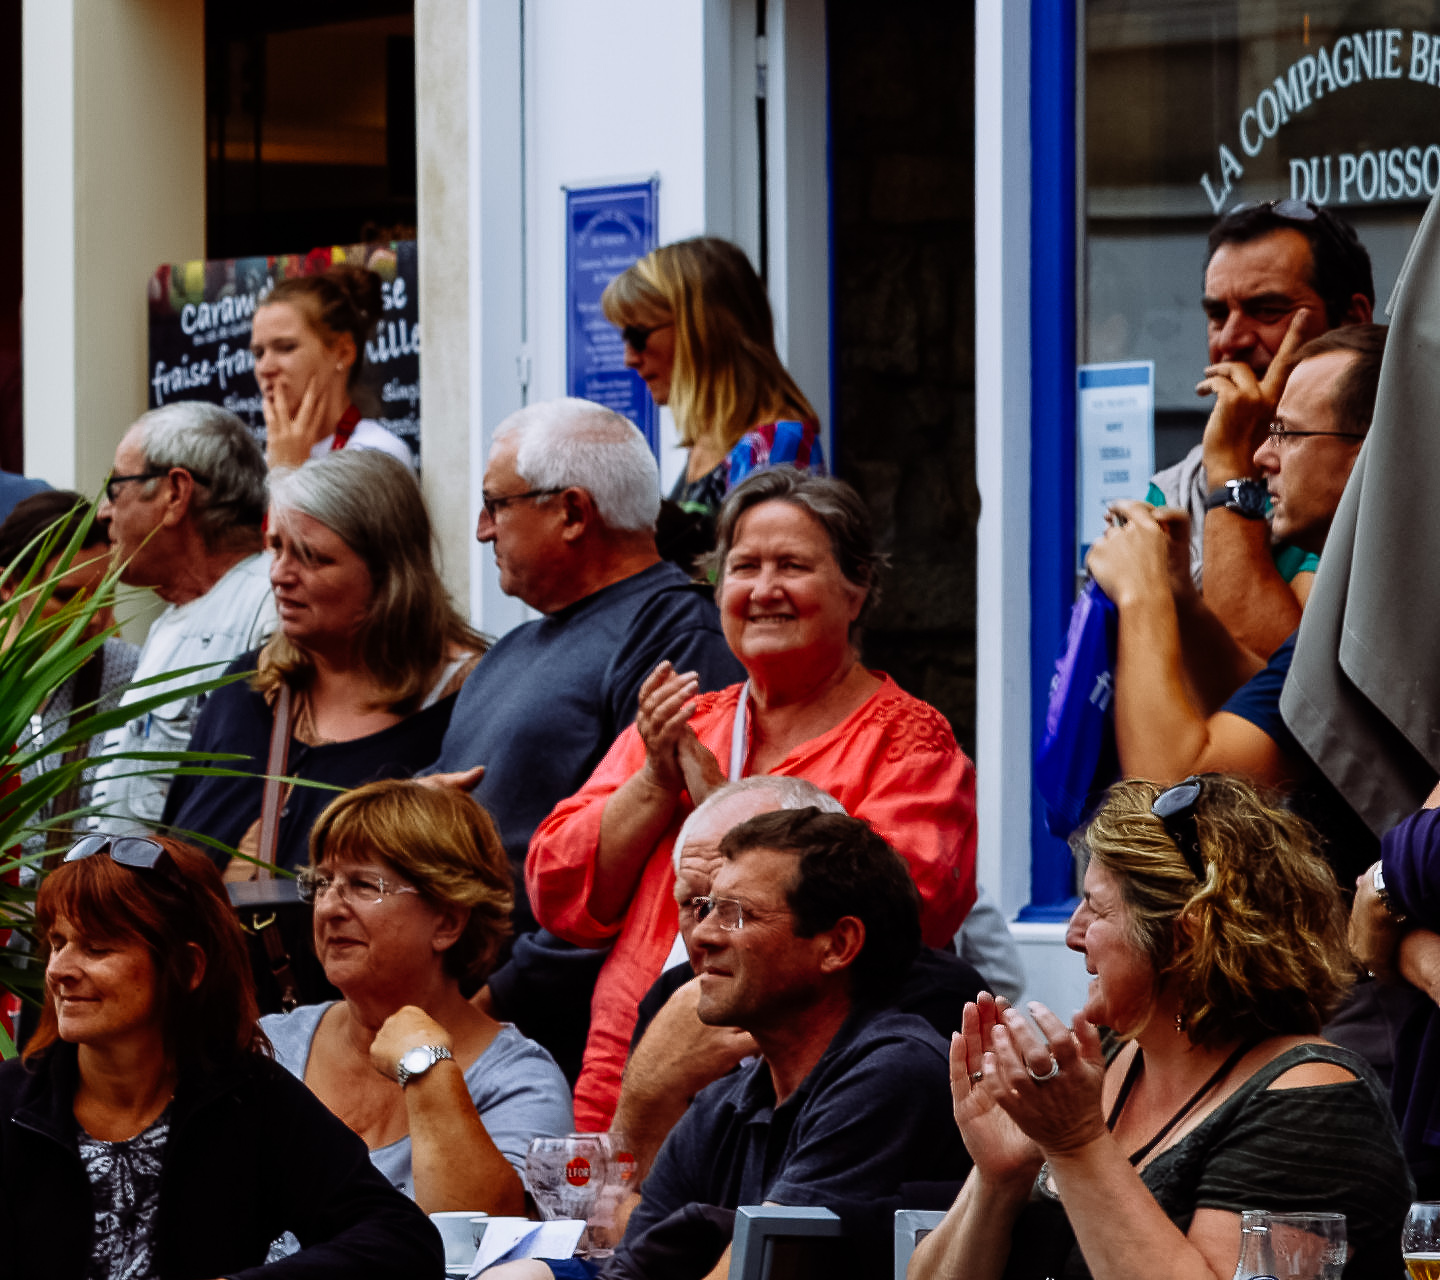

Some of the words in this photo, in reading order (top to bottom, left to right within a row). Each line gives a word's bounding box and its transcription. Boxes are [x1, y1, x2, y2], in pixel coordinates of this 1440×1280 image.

[1199, 142, 1244, 215] LA
[1239, 28, 1403, 158] COMPAGNIE
[1288, 154, 1332, 205] DU
